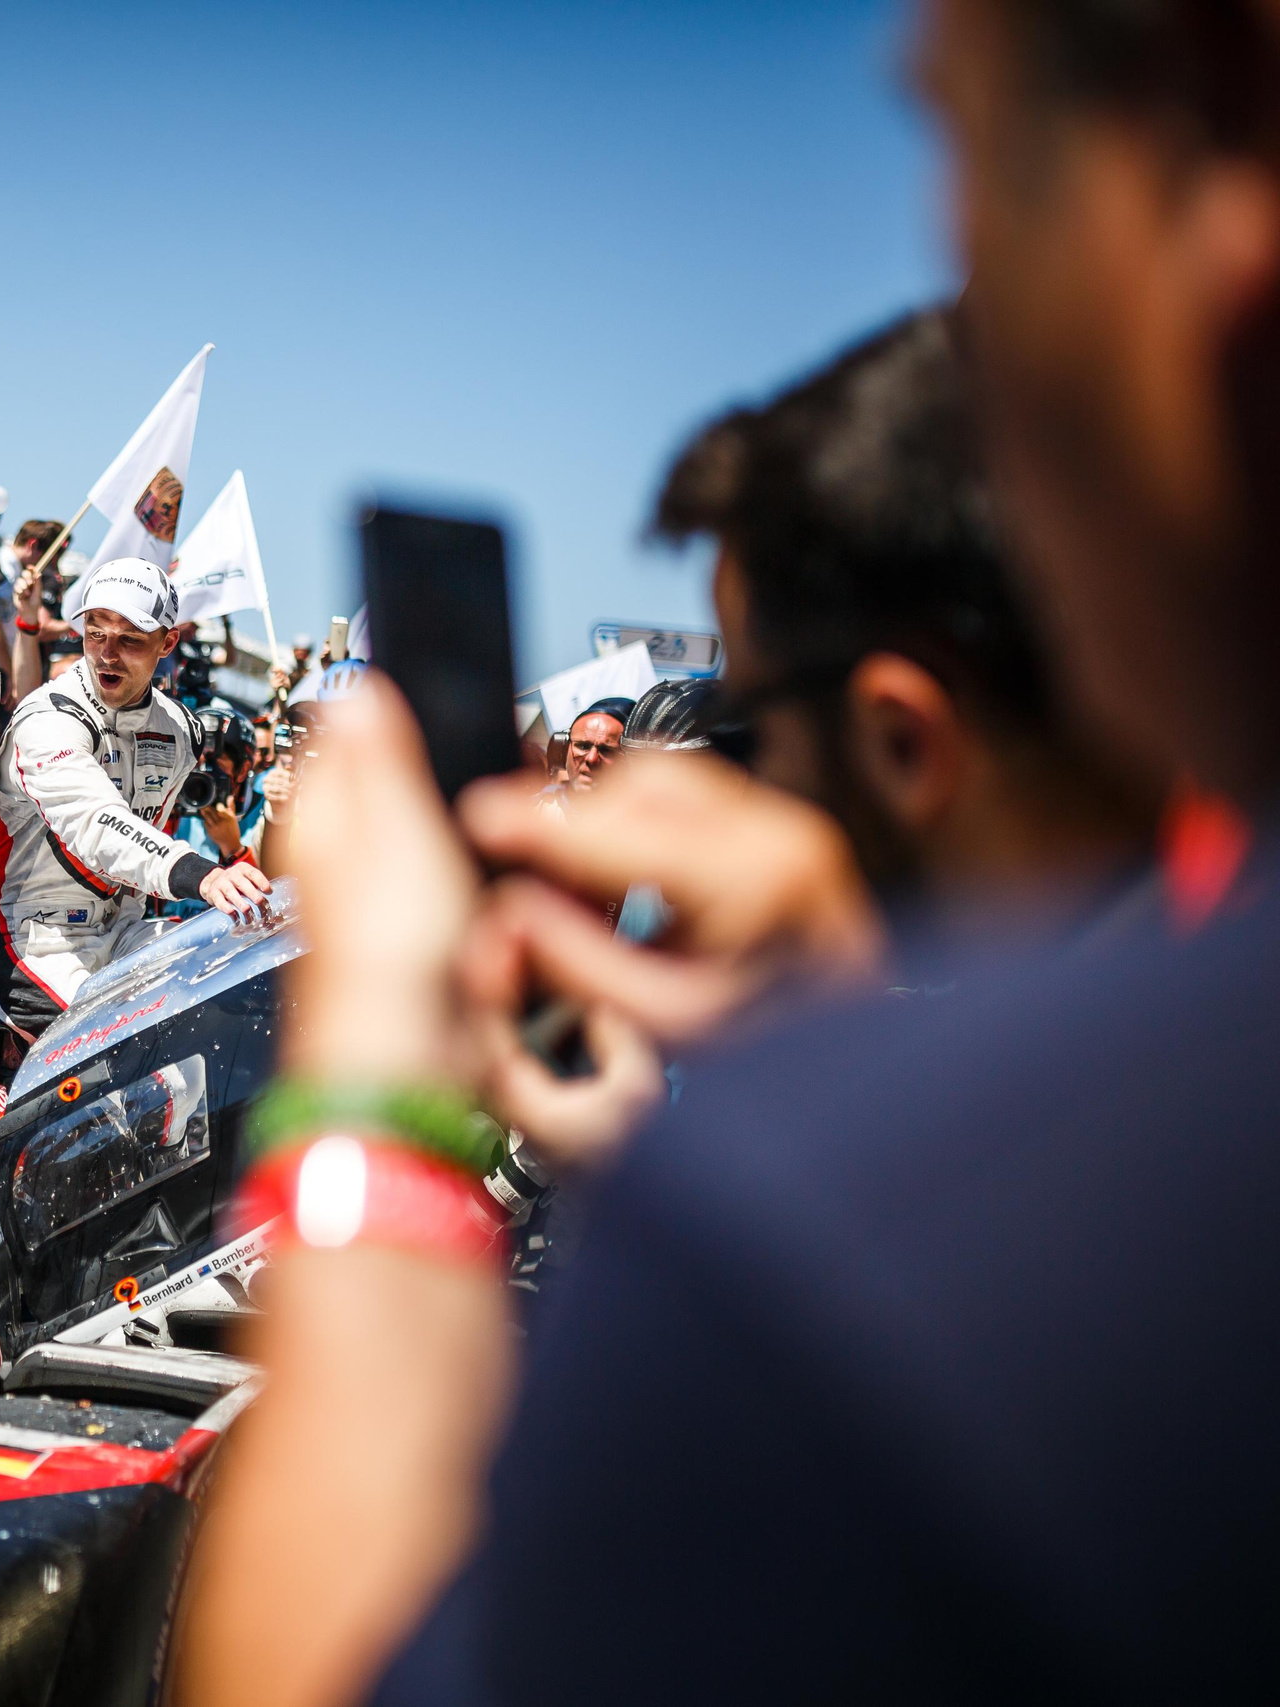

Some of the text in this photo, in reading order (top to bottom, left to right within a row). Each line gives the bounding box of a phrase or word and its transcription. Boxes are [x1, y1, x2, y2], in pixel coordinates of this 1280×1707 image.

[119, 577, 135, 585] LMP
[136, 581, 153, 594] Team
[98, 812, 134, 836] DMG
[44, 994, 167, 1067] 919 hybrid
[142, 1241, 257, 1307] Bernhard Bamber
